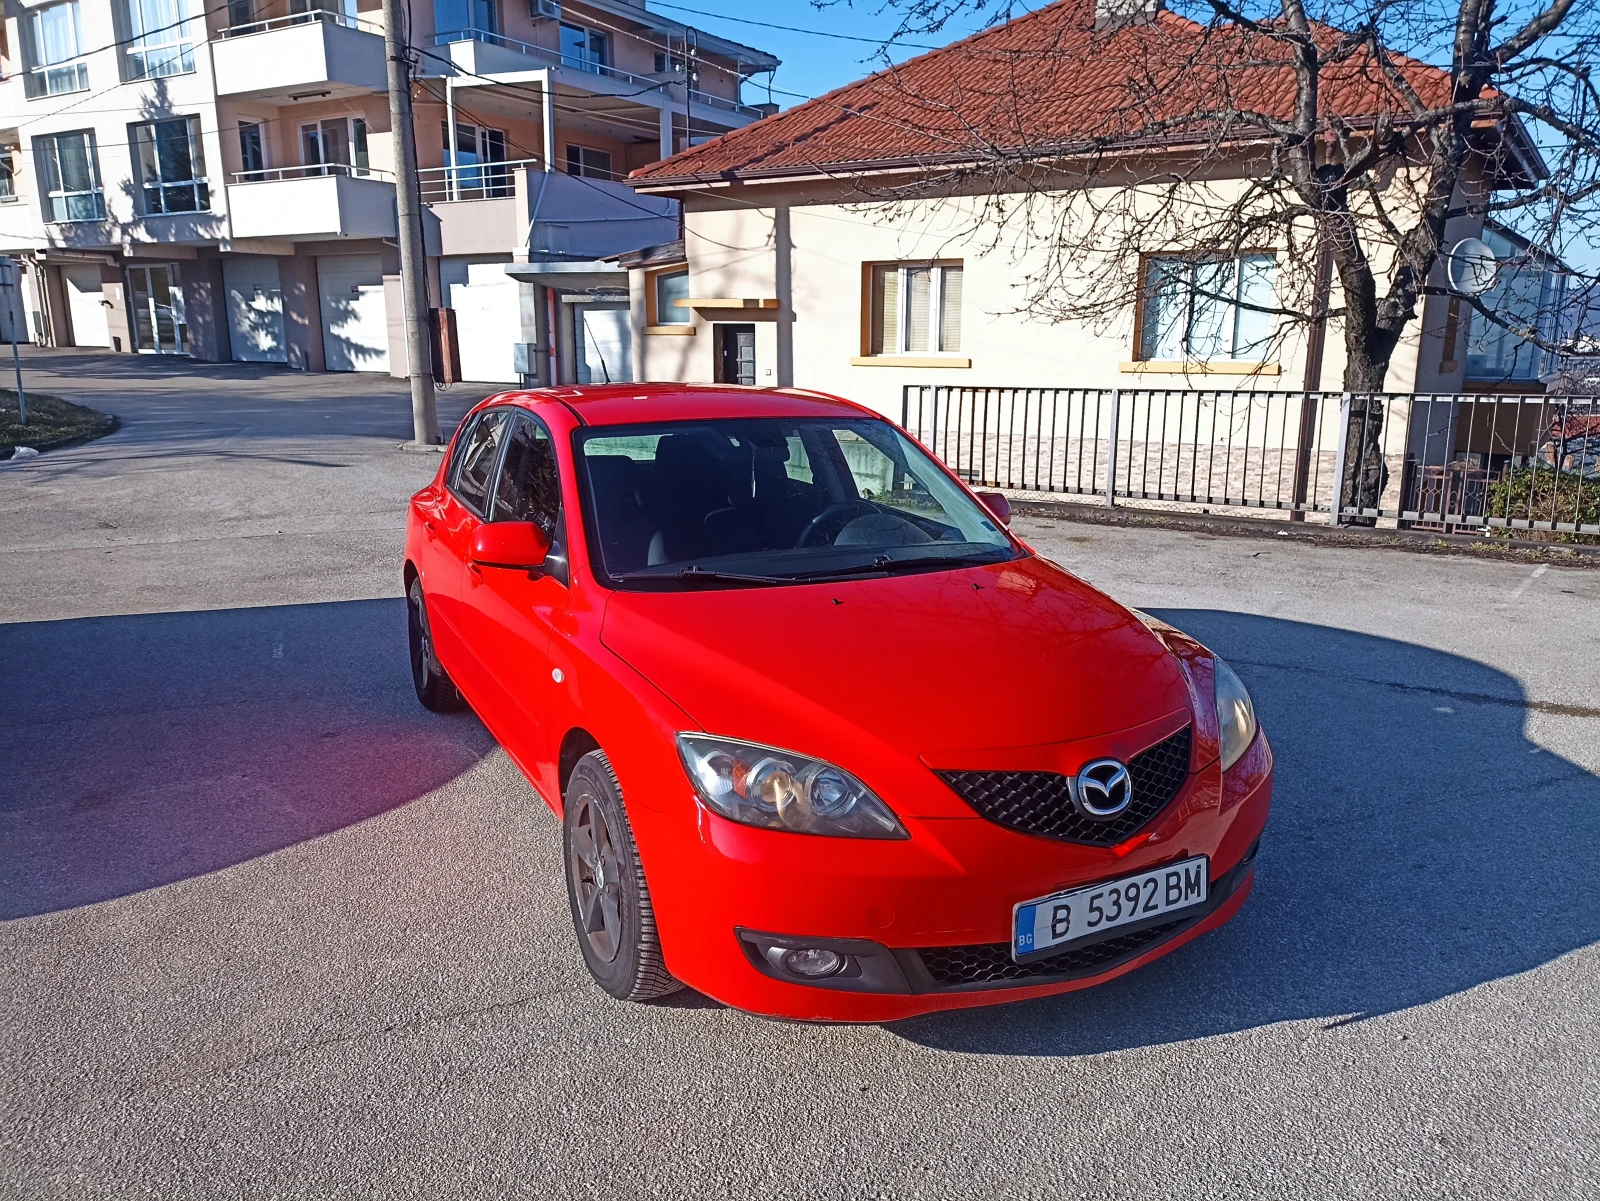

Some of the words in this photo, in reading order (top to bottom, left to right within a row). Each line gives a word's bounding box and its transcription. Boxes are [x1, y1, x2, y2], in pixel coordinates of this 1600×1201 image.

[1051, 904, 1072, 940] B
[1087, 877, 1159, 927] 5392
[1165, 864, 1202, 907] BM
[1018, 933, 1033, 946] BG
